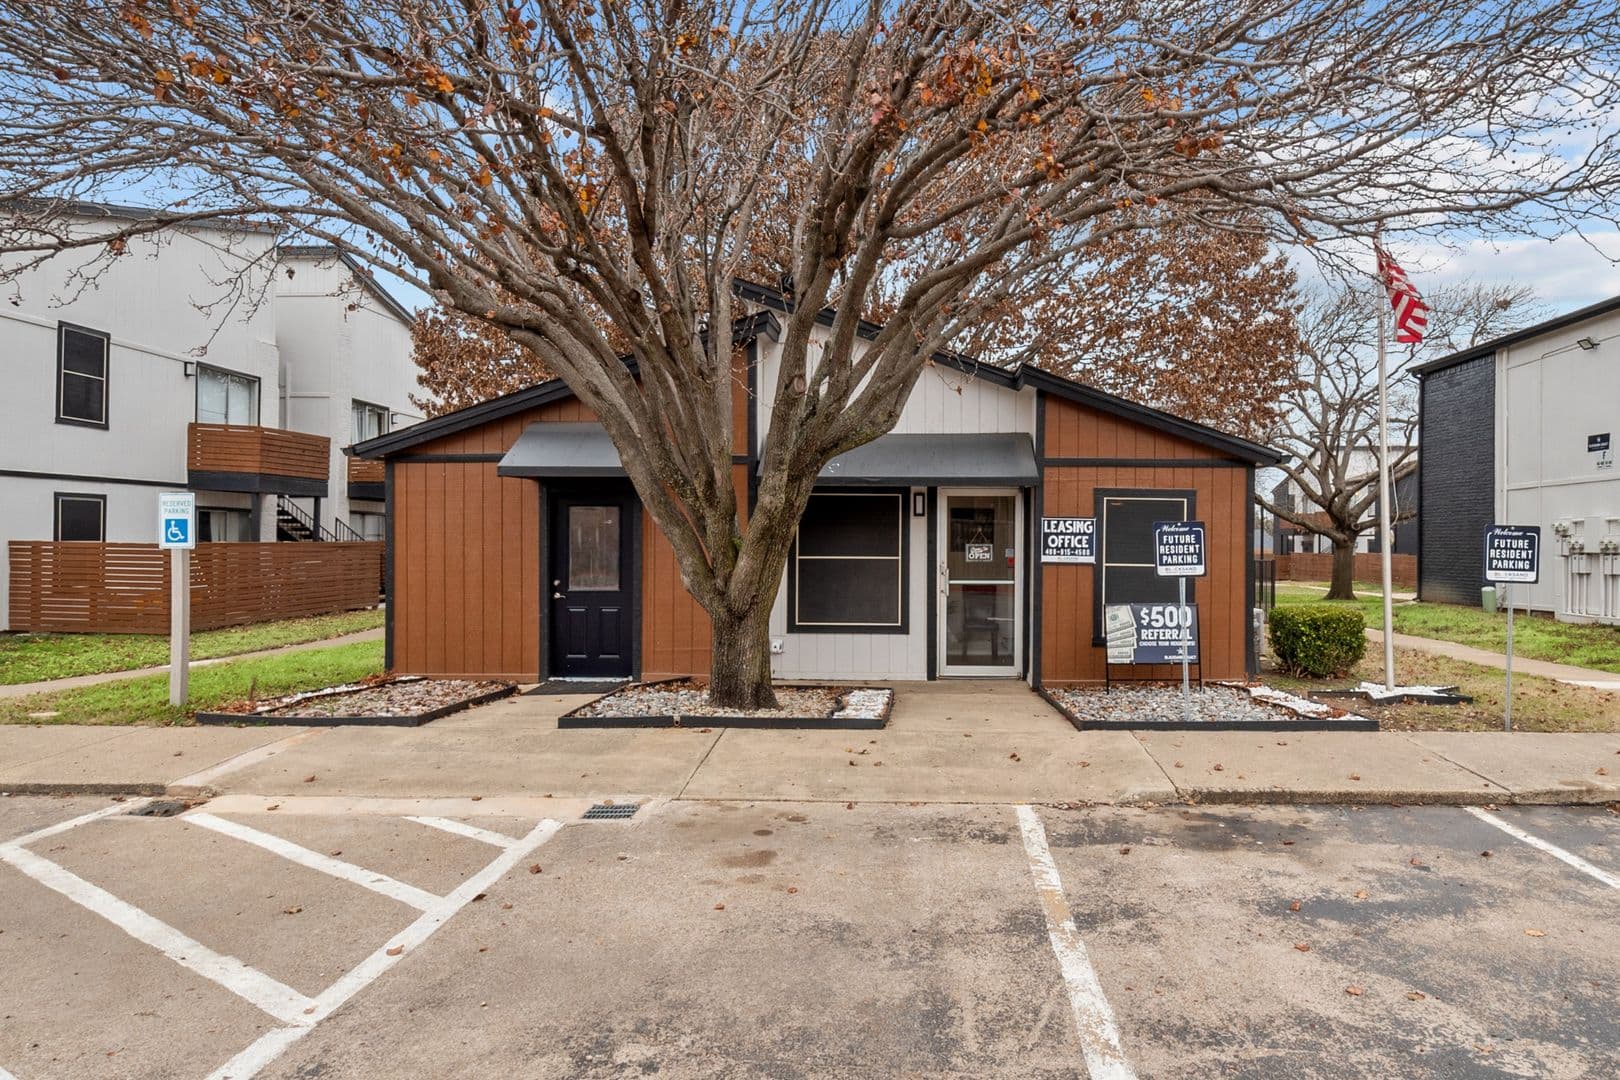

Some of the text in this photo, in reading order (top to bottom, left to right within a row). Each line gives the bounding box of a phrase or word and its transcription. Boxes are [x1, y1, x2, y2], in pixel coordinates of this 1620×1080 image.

[1044, 520, 1093, 534] LEASING
[1047, 535, 1089, 548] OFFICE
[1163, 534, 1196, 545] FUTURE
[1494, 539, 1529, 549] FUTURE
[1159, 544, 1200, 554] RESIDENT
[1490, 549, 1533, 559] RESIDENT
[968, 552, 990, 560] OPEN
[1162, 554, 1198, 565] PARKING
[1492, 559, 1530, 570] PARKING
[1140, 606, 1192, 628] $500
